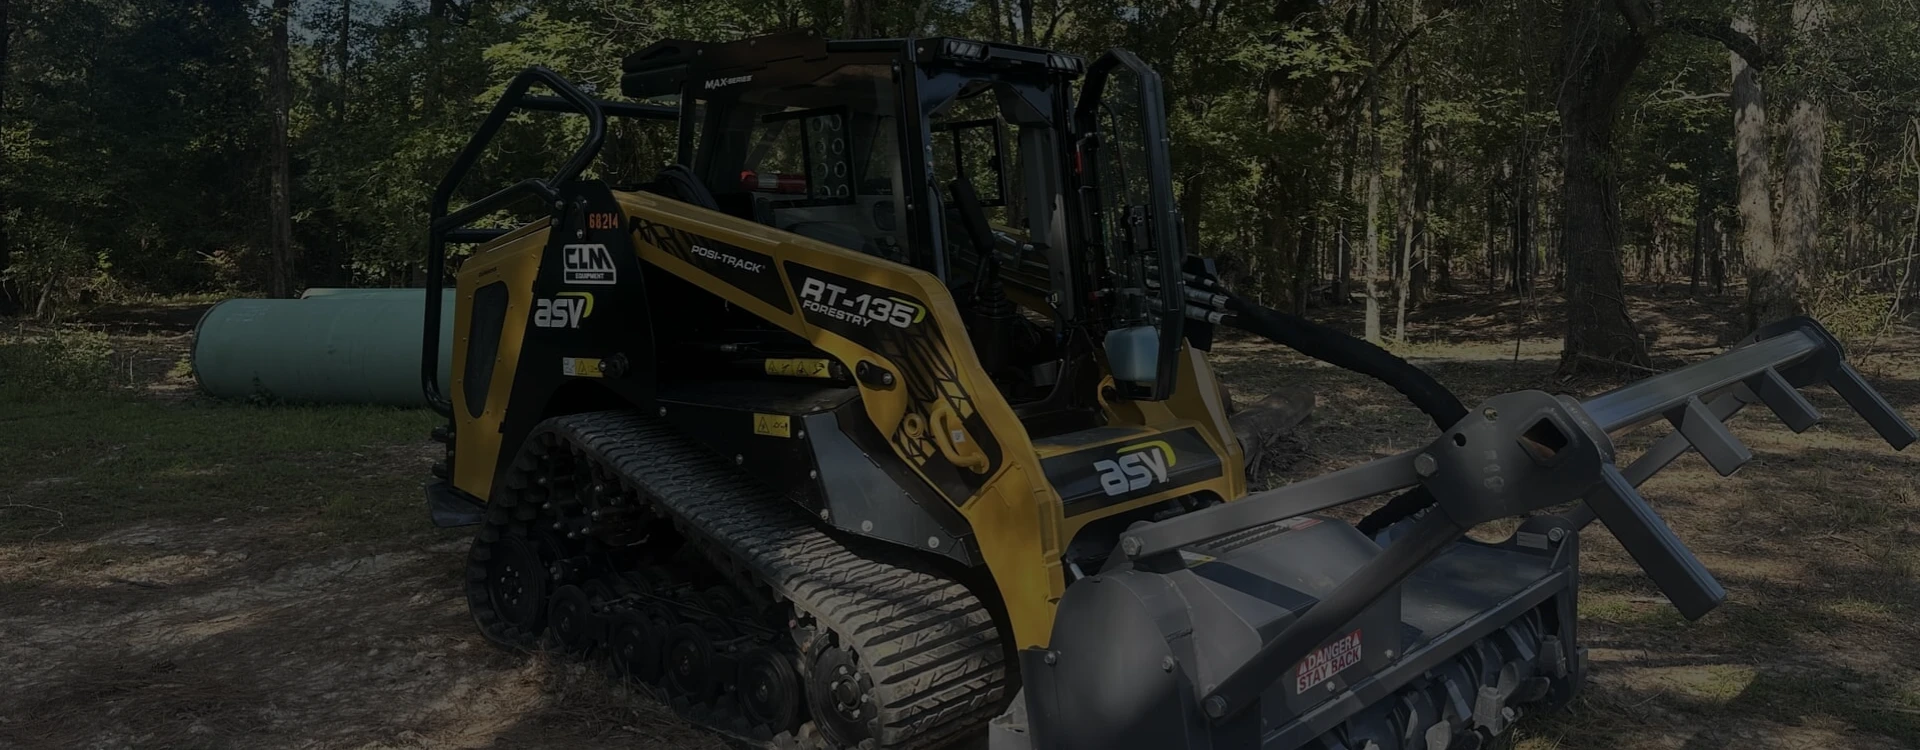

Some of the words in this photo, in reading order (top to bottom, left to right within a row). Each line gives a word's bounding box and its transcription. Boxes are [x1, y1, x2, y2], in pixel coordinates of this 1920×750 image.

[588, 212, 620, 231] 68214
[564, 247, 612, 270] CLM
[799, 276, 915, 329] RT-135
[802, 300, 872, 328] FORESTRY
[1306, 635, 1352, 670] DANGER
[1298, 663, 1329, 692] STAY
[1331, 647, 1361, 674] BACK
